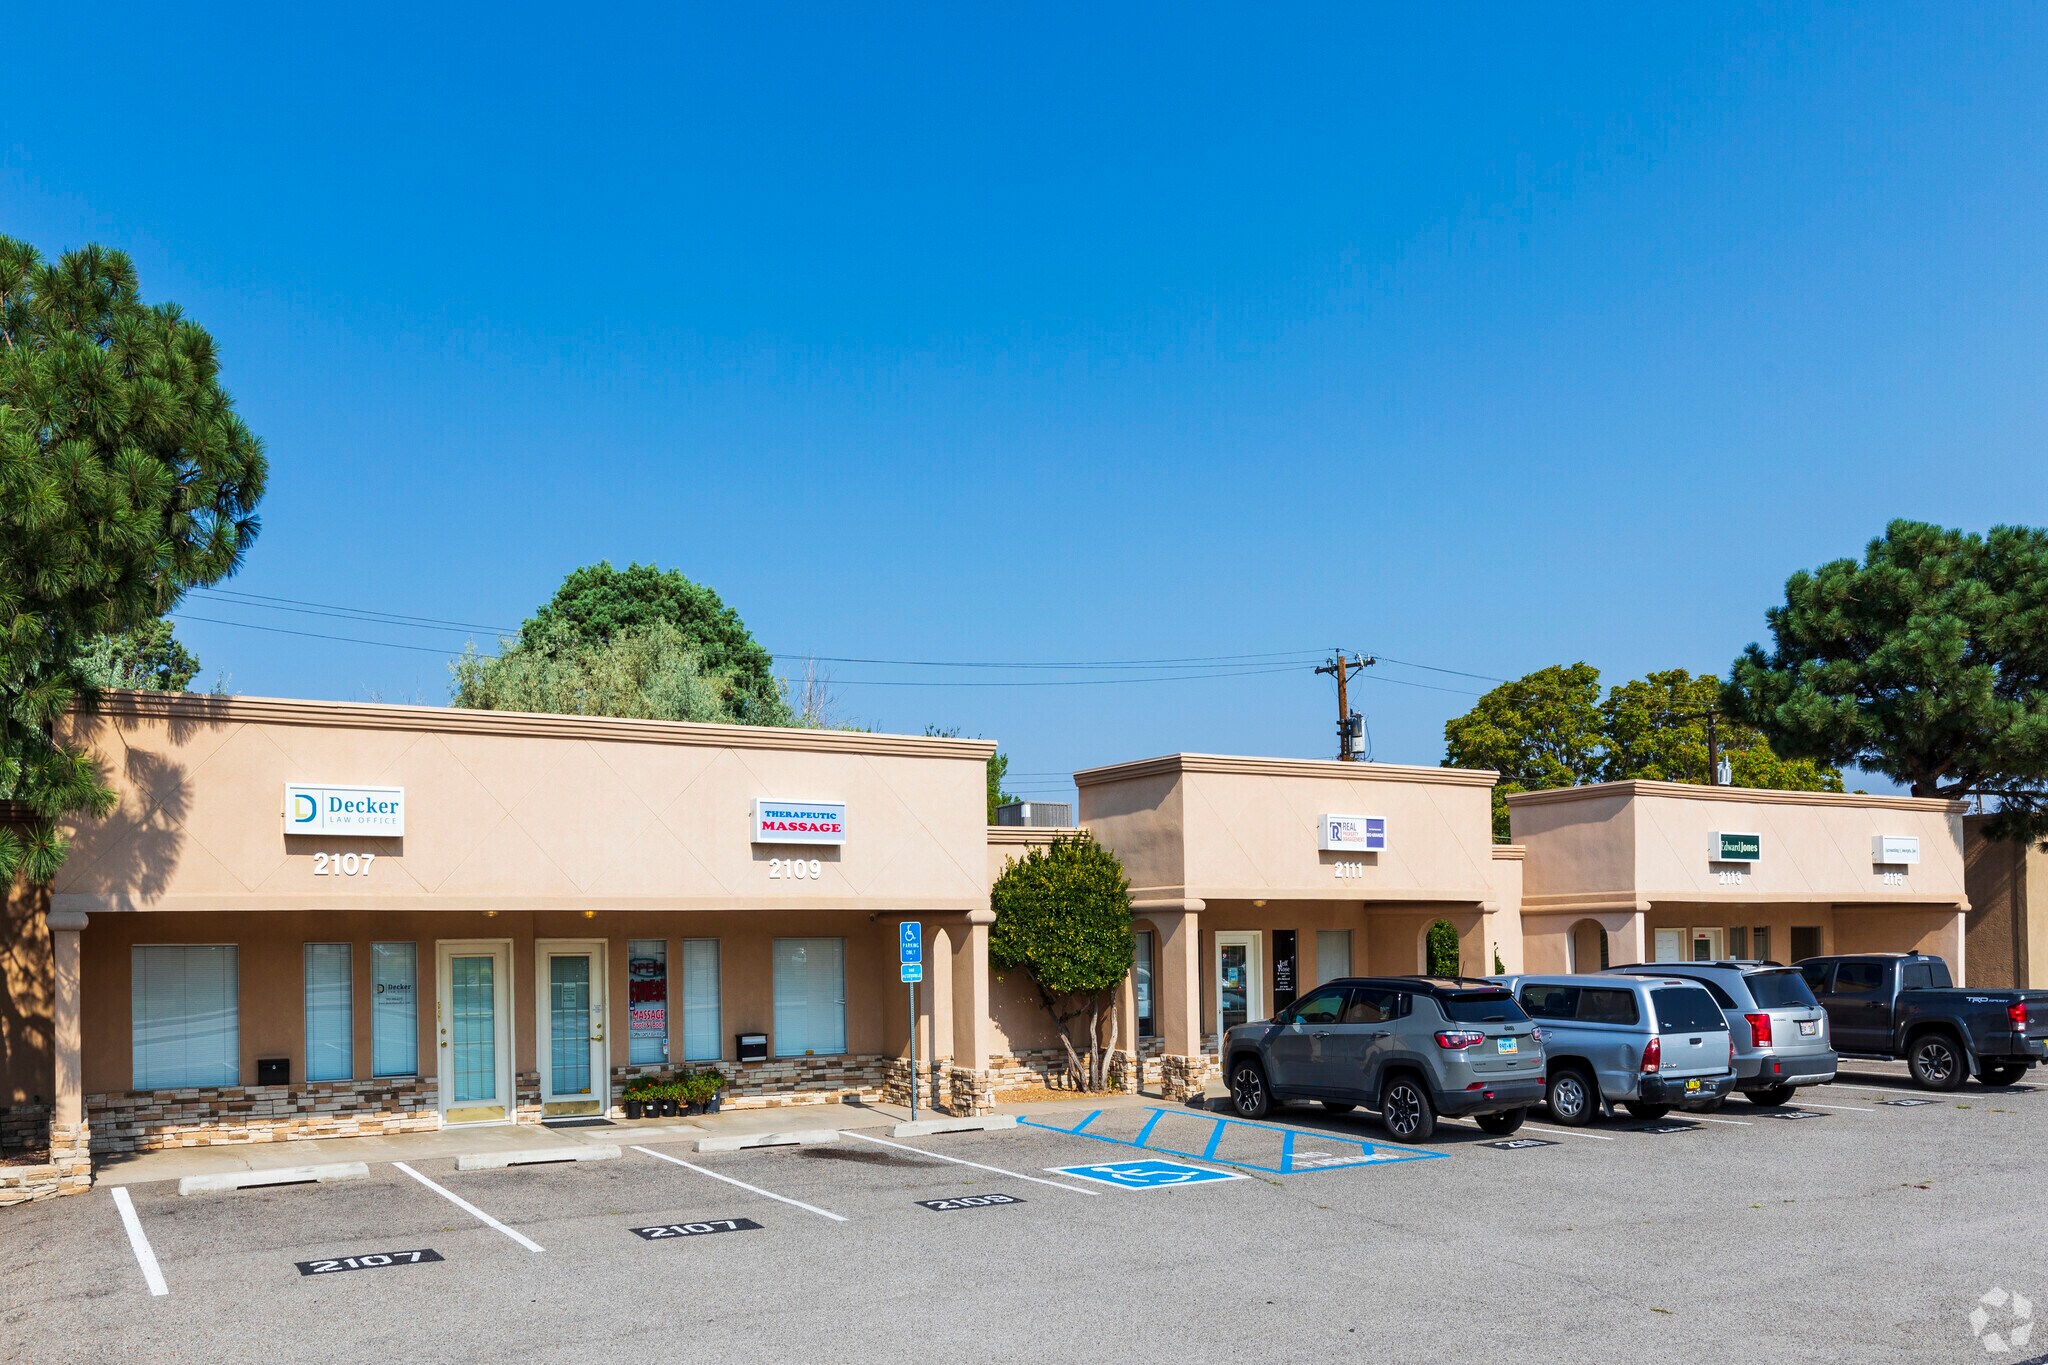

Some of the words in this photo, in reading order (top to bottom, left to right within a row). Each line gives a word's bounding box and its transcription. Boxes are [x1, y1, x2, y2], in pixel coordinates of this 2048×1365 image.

[328, 796, 400, 814] Decker
[358, 817, 397, 825] OFFICE
[765, 810, 837, 820] THERAPEUTIC
[762, 821, 842, 833] MASSAGE
[1343, 822, 1357, 832] REAL
[314, 852, 375, 876] 2107
[769, 858, 821, 880] 2109
[1335, 861, 1363, 878] 2111
[632, 1009, 665, 1020] MASSAGE
[632, 1021, 644, 1029] Foot
[652, 1021, 665, 1030] Body
[927, 1195, 1014, 1209] 2109
[642, 1220, 737, 1238] 2107
[309, 1251, 421, 1273] 2107
